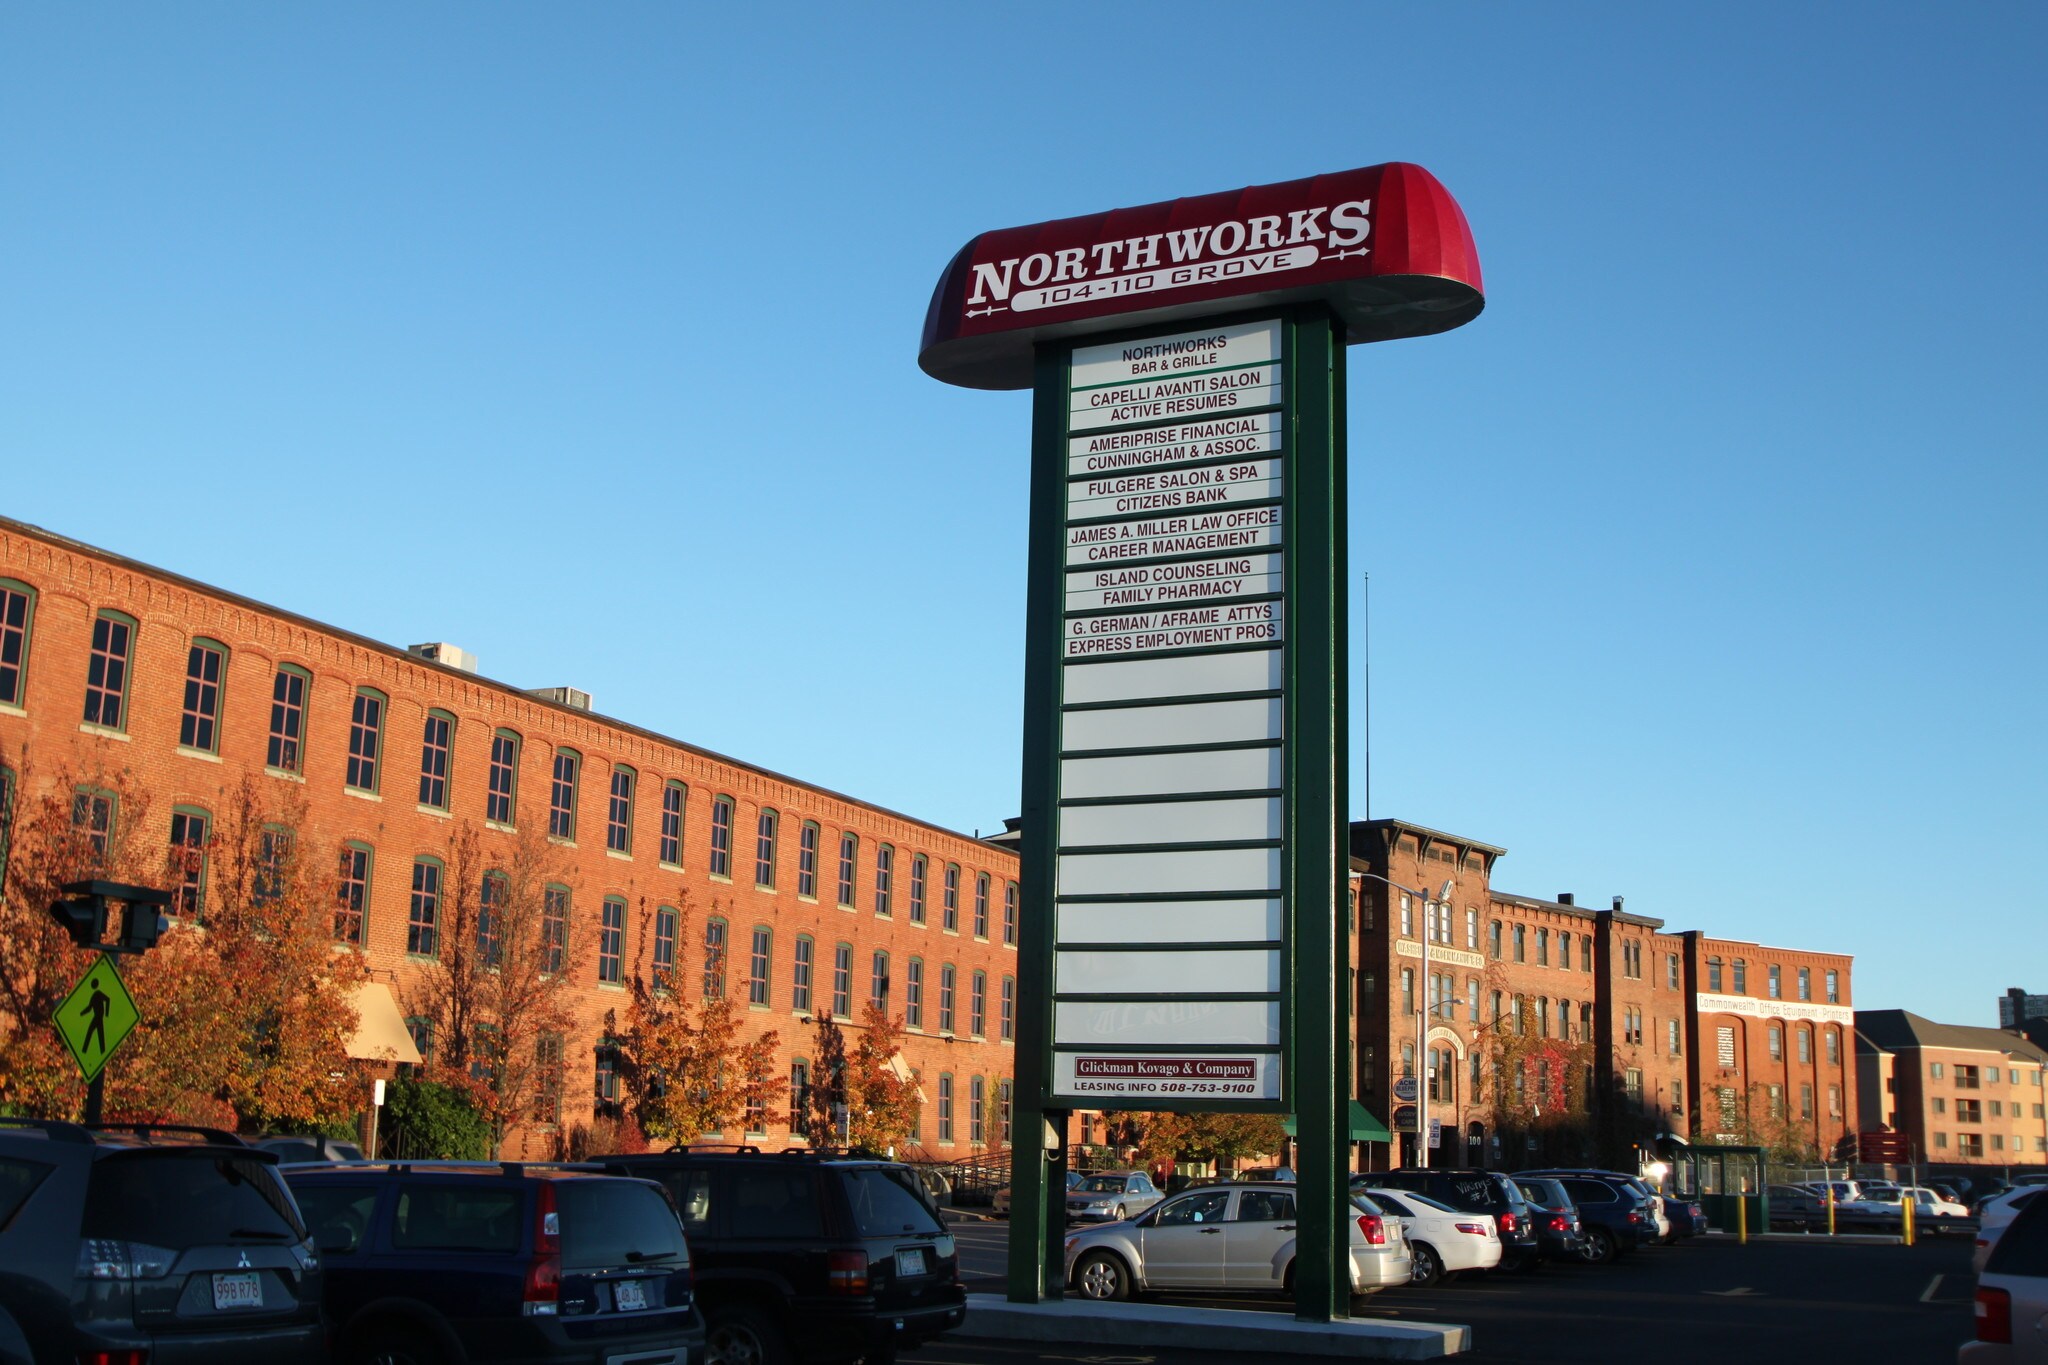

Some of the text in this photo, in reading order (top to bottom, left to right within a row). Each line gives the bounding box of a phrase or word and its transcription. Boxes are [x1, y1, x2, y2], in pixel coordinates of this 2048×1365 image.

[967, 199, 1371, 305] NORTHWORKS
[1038, 252, 1292, 305] 104-110 GROVE
[1122, 335, 1227, 362] NORTHWORKS
[1131, 352, 1217, 375] BAR & GRILLE
[1090, 371, 1260, 407] CAPELLI AVANTI SALON
[1111, 393, 1237, 421] ACTIVE RESUMES
[1089, 419, 1260, 452] AMERIPRISE FINANCIAL
[1087, 437, 1260, 470] CUNNINGHAM & ASSOC.
[1089, 465, 1258, 495] FULGERE SALON & SPA
[1116, 487, 1227, 512] CITIZENS BANK
[1071, 509, 1278, 544] JAMES A. MILLER LAW OFFICE
[1088, 530, 1259, 560] CAREER MANAGEMENT
[1096, 560, 1251, 587] ISLAND COUNSELING
[1103, 579, 1242, 605] FAMILY PHARMACY
[1073, 604, 1272, 635] G. GERMAN / AFRAME ATTYS
[1069, 623, 1275, 654] EXPRESS EMPLOYMENT PROS
[1699, 995, 1849, 1020] Commonwealth Office Equipment Printers
[1080, 1061, 1252, 1077] Glickman Kovago & Company
[1074, 1082, 1255, 1093] LEASING INFO 508-753-9100
[1469, 1136, 1482, 1145] 100
[1456, 1179, 1491, 1194] Vikings
[217, 1281, 259, 1300] 99B R78
